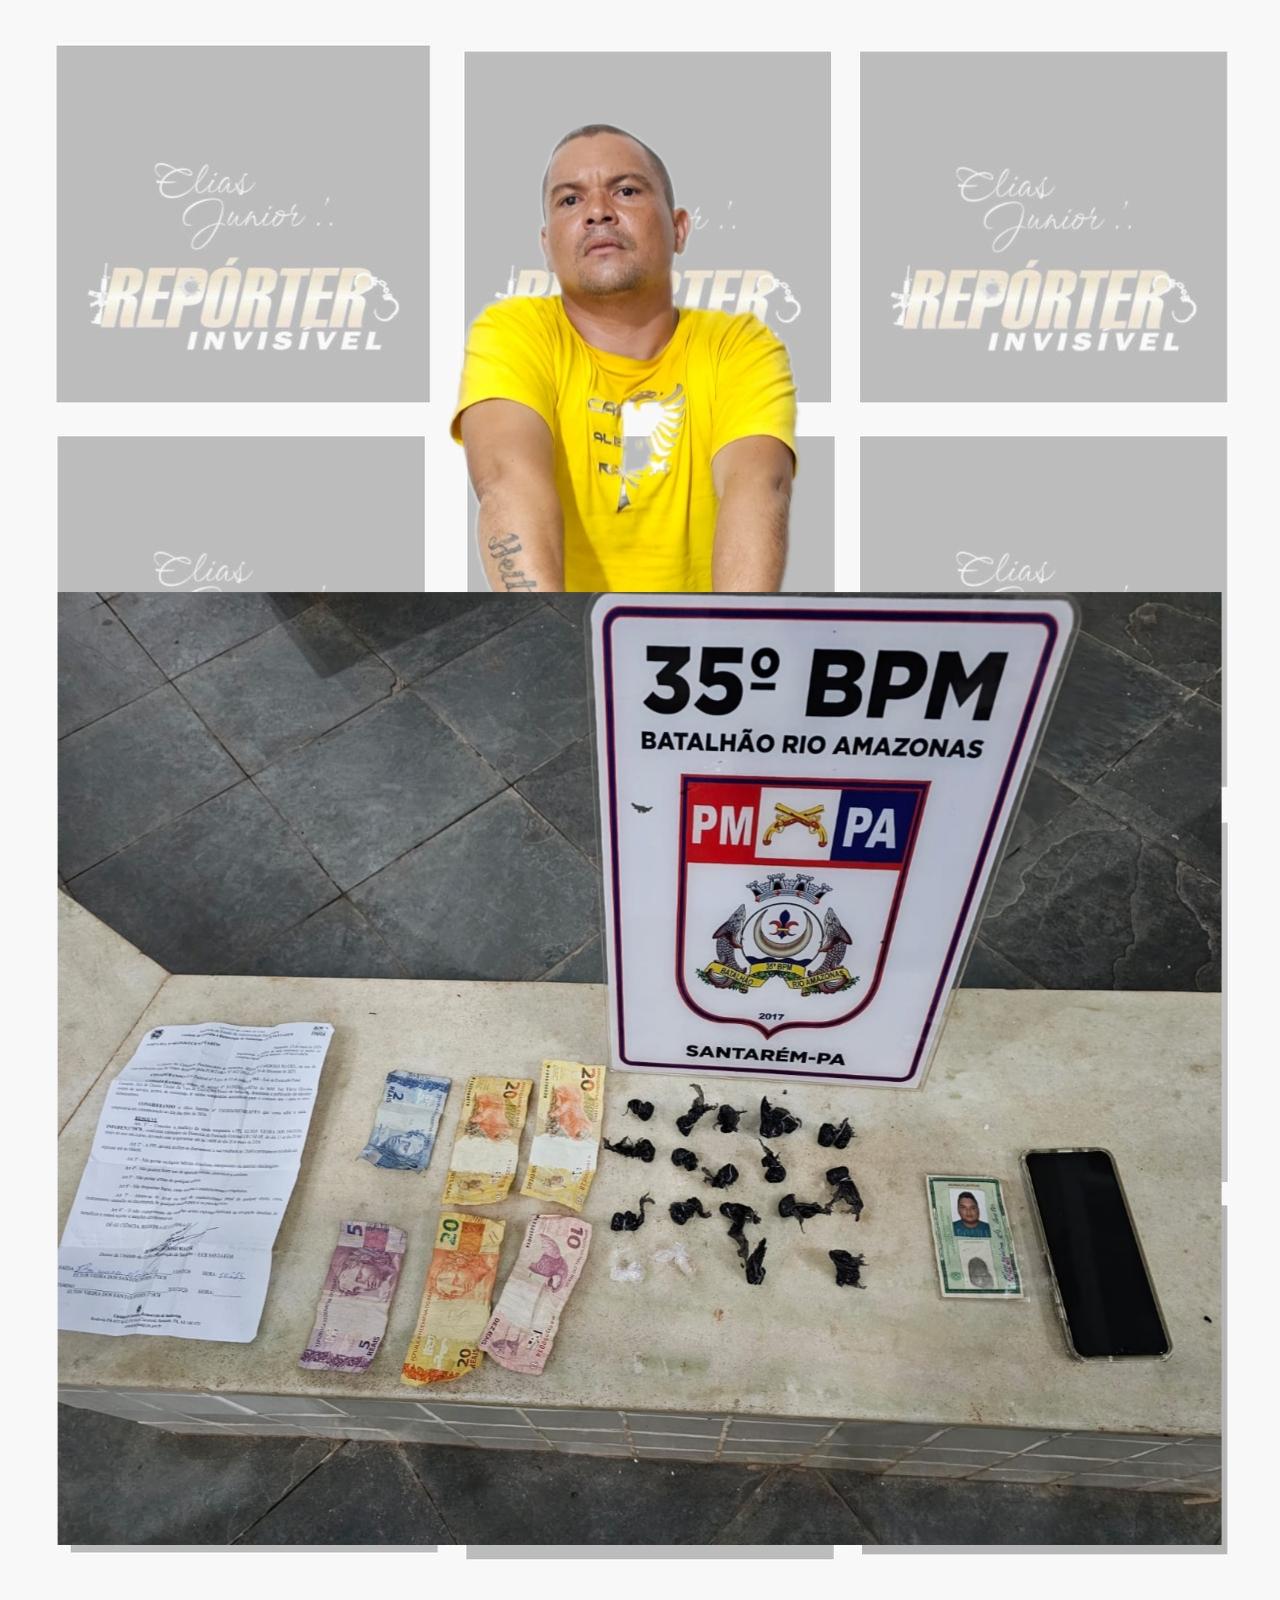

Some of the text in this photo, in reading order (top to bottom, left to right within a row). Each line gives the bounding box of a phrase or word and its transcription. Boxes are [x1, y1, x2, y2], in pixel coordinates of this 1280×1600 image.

[805, 648, 1009, 722] BPM
[641, 728, 984, 758] BATALHÃO RIO AMAZONAS
[691, 804, 897, 849] PM PA
[720, 967, 754, 985] BATALHÃO
[806, 970, 845, 987] AMAZONAS
[777, 963, 793, 971] BPM
[758, 1012, 784, 1021] 2017
[686, 1044, 845, 1066] SANTARÉM-PA
[580, 1067, 596, 1091] 20
[393, 1091, 404, 1101] 2
[503, 1081, 520, 1099] 20
[347, 1224, 363, 1237] 5
[440, 1218, 459, 1245] 20
[567, 1227, 584, 1249] 10
[489, 1317, 500, 1332] DEZ
[358, 1340, 371, 1350] 5
[366, 1336, 380, 1356] REAIS
[457, 1348, 471, 1368] 20
